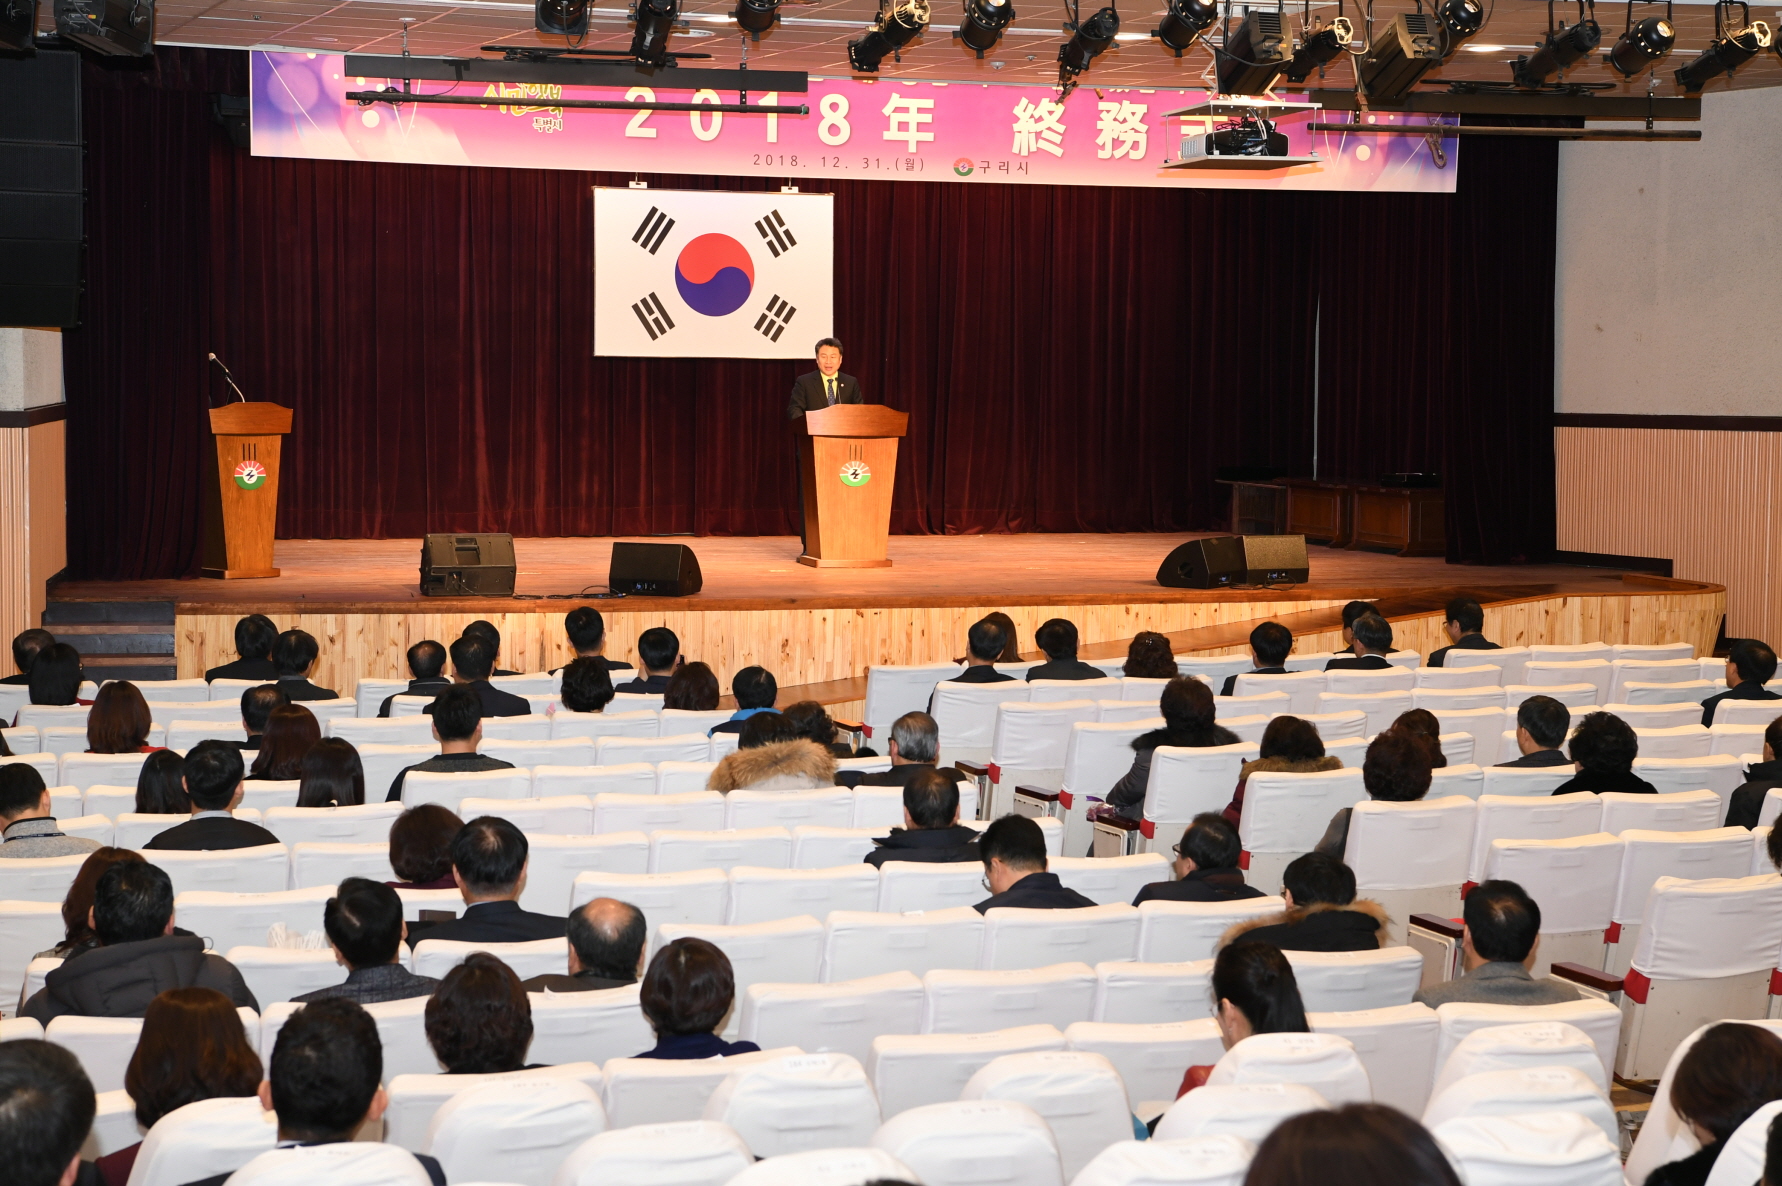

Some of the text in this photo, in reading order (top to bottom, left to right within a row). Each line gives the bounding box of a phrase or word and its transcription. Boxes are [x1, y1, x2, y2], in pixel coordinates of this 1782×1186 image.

[532, 117, 563, 133] 특별시
[753, 154, 806, 168] 2018.
[821, 156, 848, 169] 12.
[978, 160, 1029, 176] 구리시
